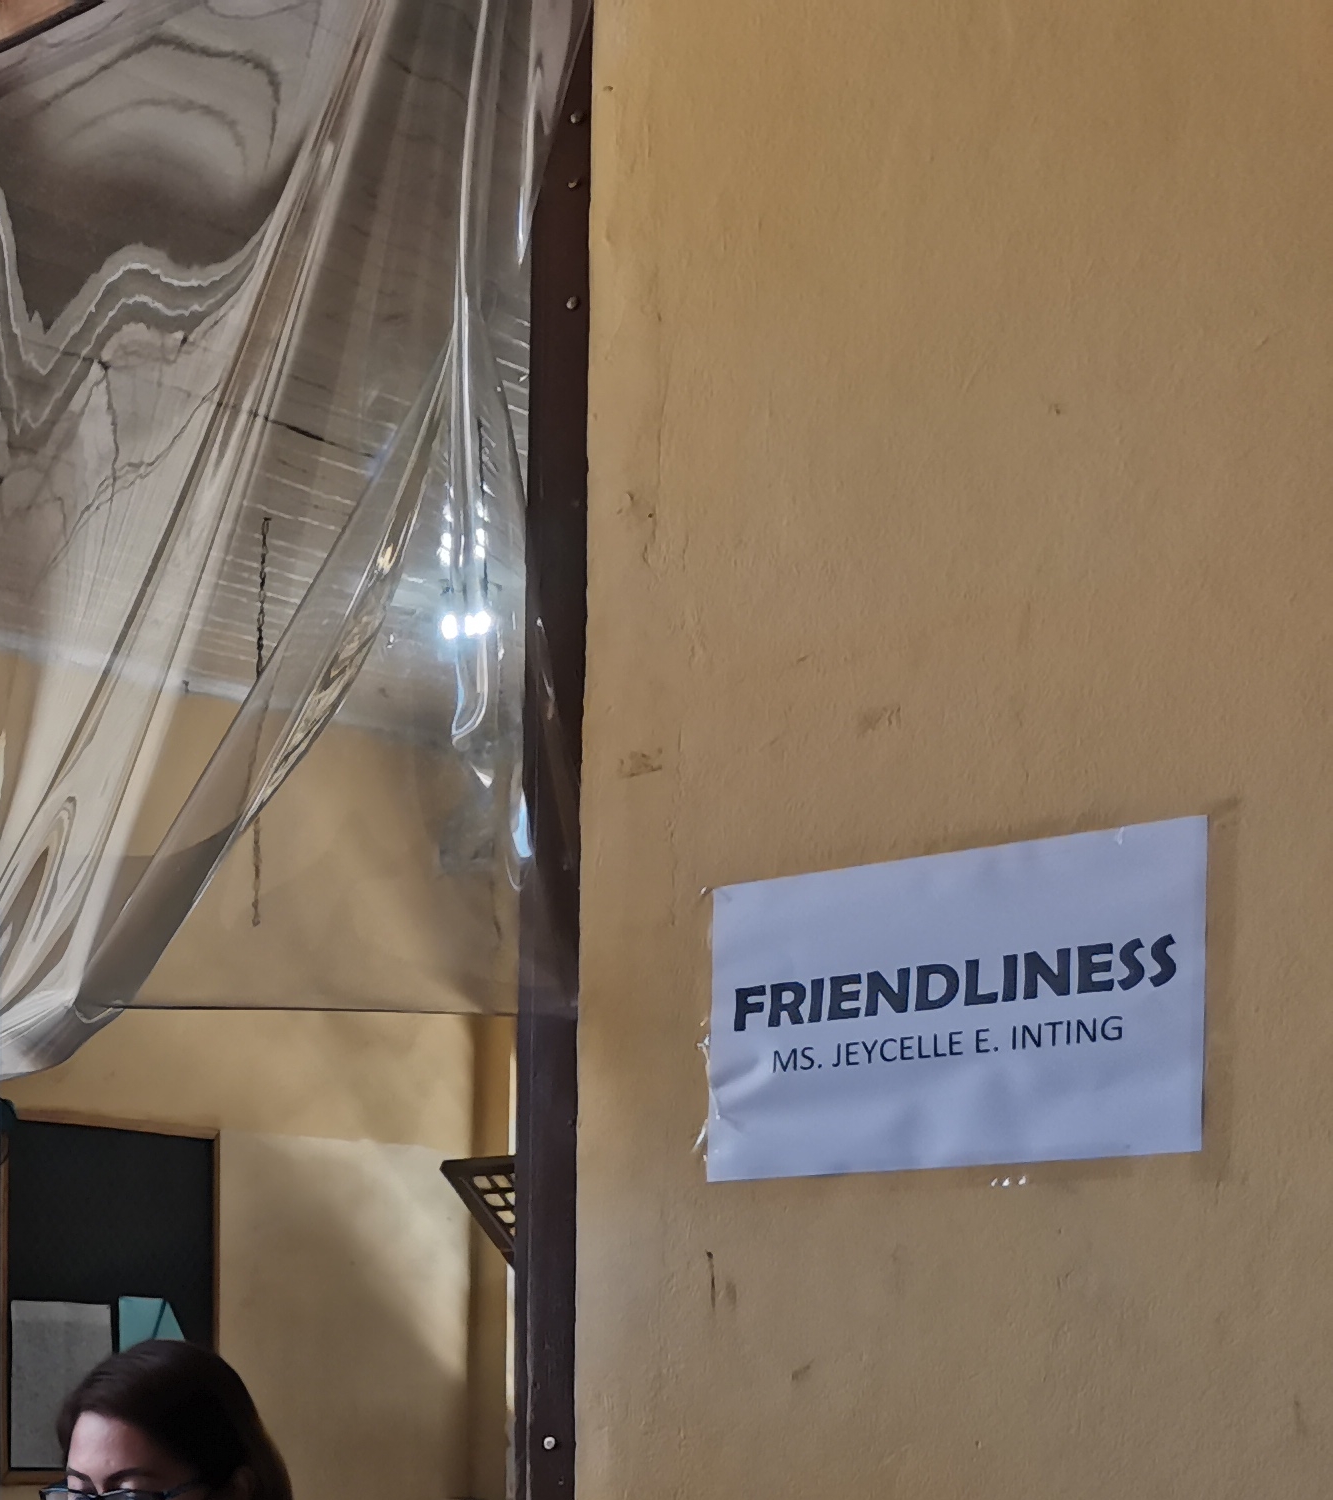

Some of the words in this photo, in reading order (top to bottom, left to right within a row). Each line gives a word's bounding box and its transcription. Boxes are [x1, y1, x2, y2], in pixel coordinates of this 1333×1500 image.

[734, 934, 1177, 1032] FRIENDLINESS
[772, 1047, 823, 1073] MS.
[832, 1031, 964, 1067] JEYCELLE
[975, 1029, 999, 1053] E.
[1012, 1016, 1124, 1050] INTING
